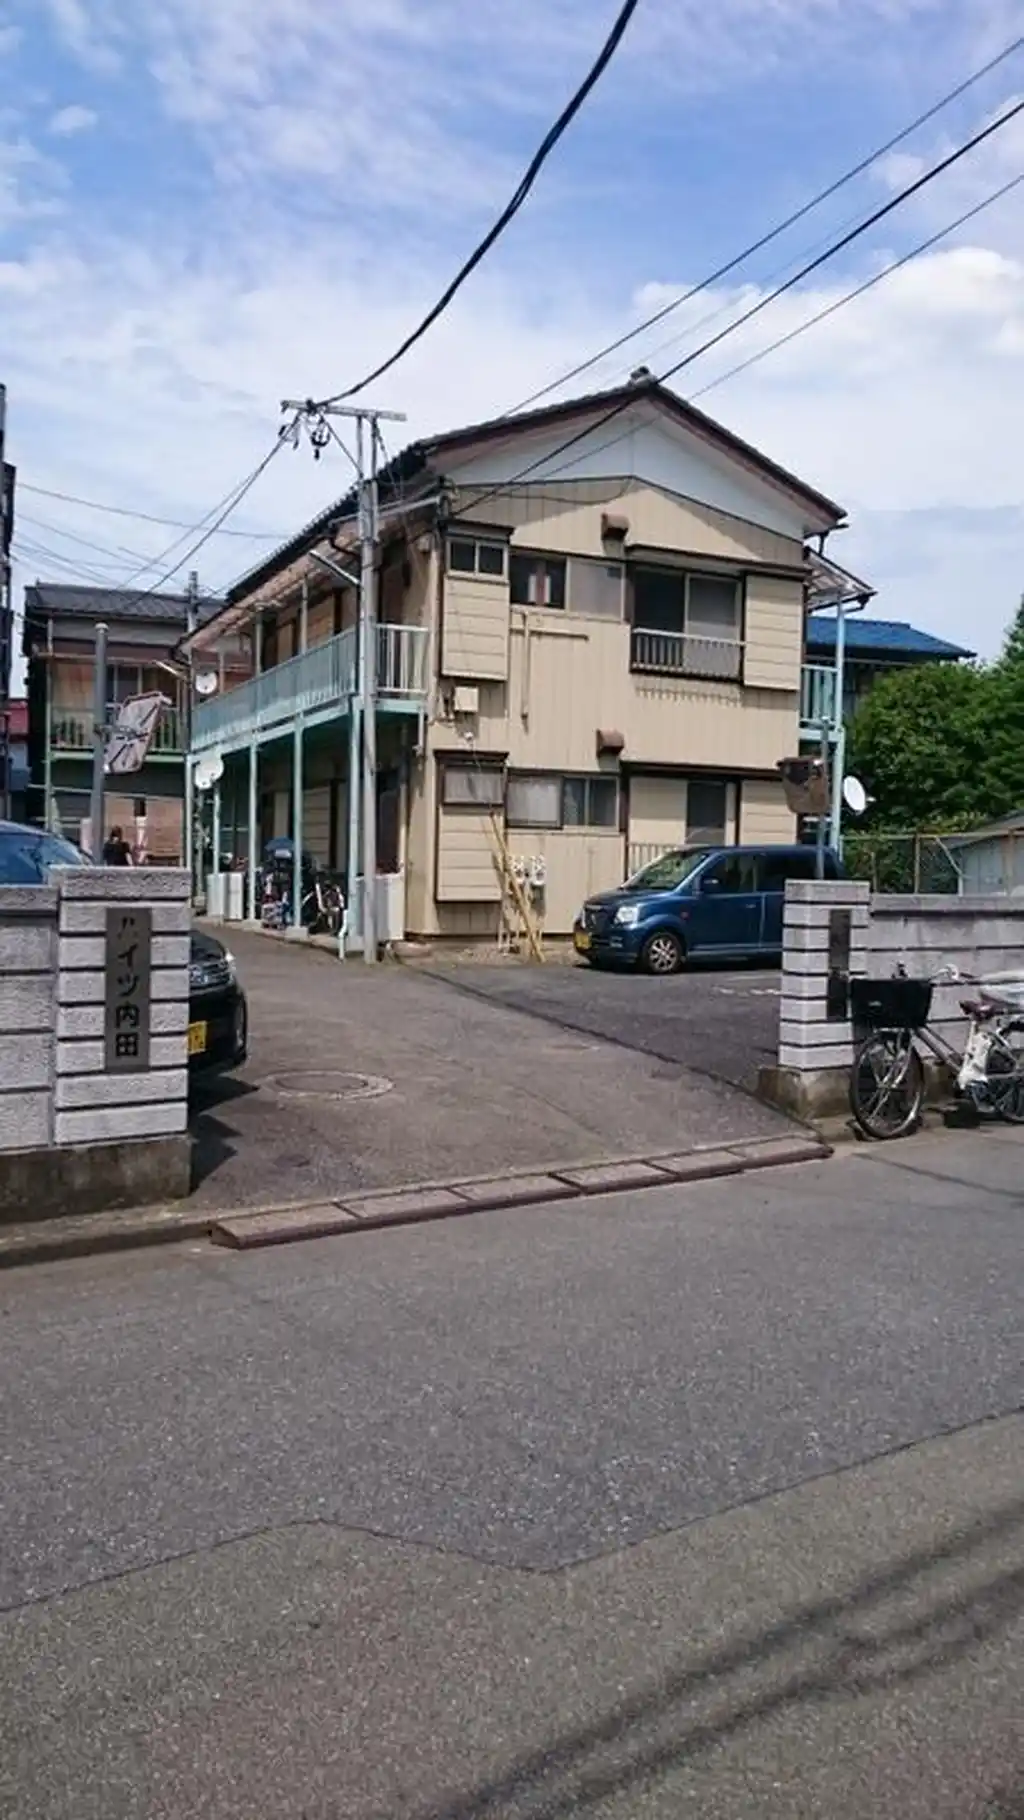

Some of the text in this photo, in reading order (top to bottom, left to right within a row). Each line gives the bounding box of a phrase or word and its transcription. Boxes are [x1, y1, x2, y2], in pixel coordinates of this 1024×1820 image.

[115, 916, 140, 1057] ハイツ内田
